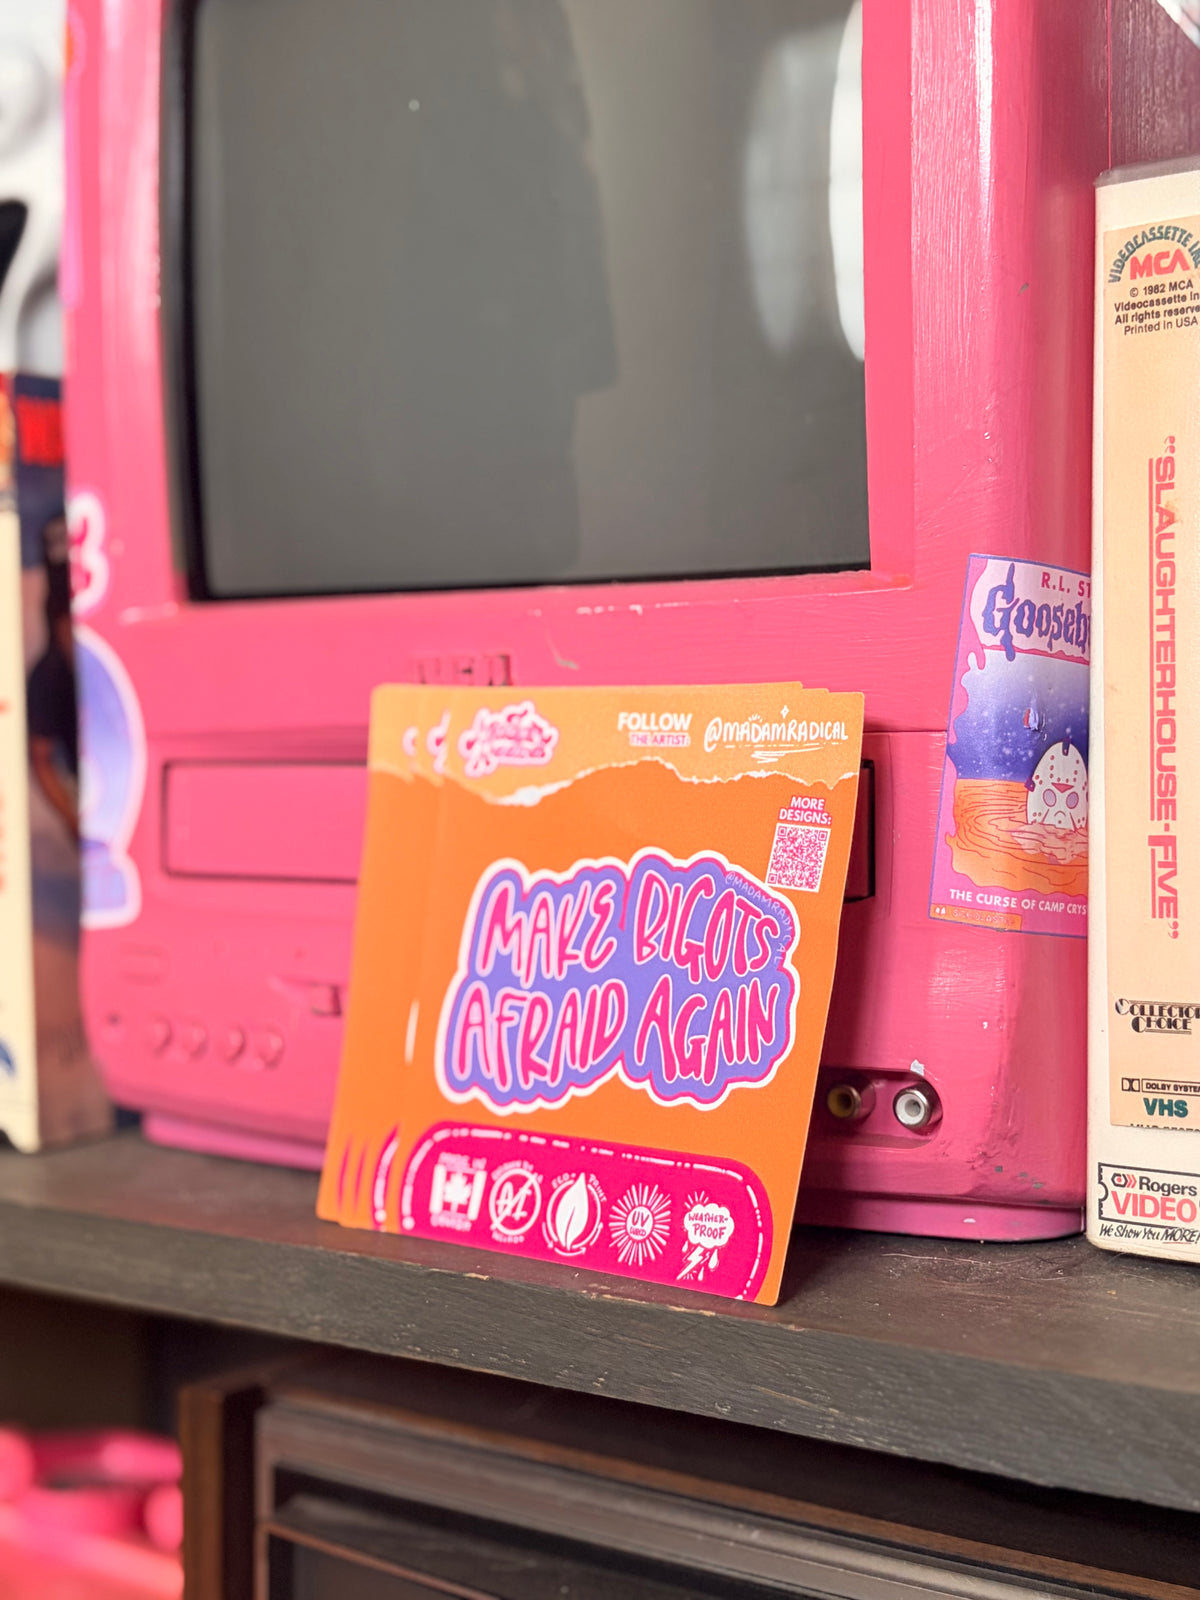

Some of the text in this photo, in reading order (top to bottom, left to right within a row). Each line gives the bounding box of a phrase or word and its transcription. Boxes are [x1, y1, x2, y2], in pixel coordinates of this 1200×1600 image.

[1108, 225, 1193, 283] VIDEOCASSETTE
[1130, 248, 1190, 280] MCA
[1143, 284, 1166, 296] 1982
[1168, 279, 1193, 292] MCA
[1114, 294, 1187, 313] Videocassette
[1115, 313, 1129, 325] All
[1131, 310, 1161, 323] rights
[1124, 315, 1198, 336] Printed in USA
[1041, 571, 1070, 594] R.L.
[982, 562, 1090, 662] Gooseb
[617, 712, 692, 731] FOLLOW
[630, 732, 649, 746] THE
[791, 796, 824, 811] MORE
[779, 808, 832, 825] DESIGNS:
[950, 889, 972, 902] THE
[976, 893, 1017, 908] CURSE
[1021, 899, 1036, 911] OF
[1039, 900, 1065, 913] CAMP
[476, 870, 780, 987] MAKE BIGOTS
[724, 871, 793, 965] @MADAMRADICAL
[453, 975, 780, 1090] AFRAID AGAIN
[1145, 1082, 1171, 1091] DOLBY
[1143, 1097, 1188, 1118] VHS
[589, 1173, 607, 1202] PRINT
[1139, 1175, 1197, 1197] Rogers
[1111, 1190, 1198, 1224] VIDEO
[632, 1210, 649, 1227] UV
[692, 1222, 726, 1239] PROOF
[1099, 1223, 1114, 1238] We
[1114, 1224, 1141, 1239] Show
[1142, 1227, 1160, 1240] You
